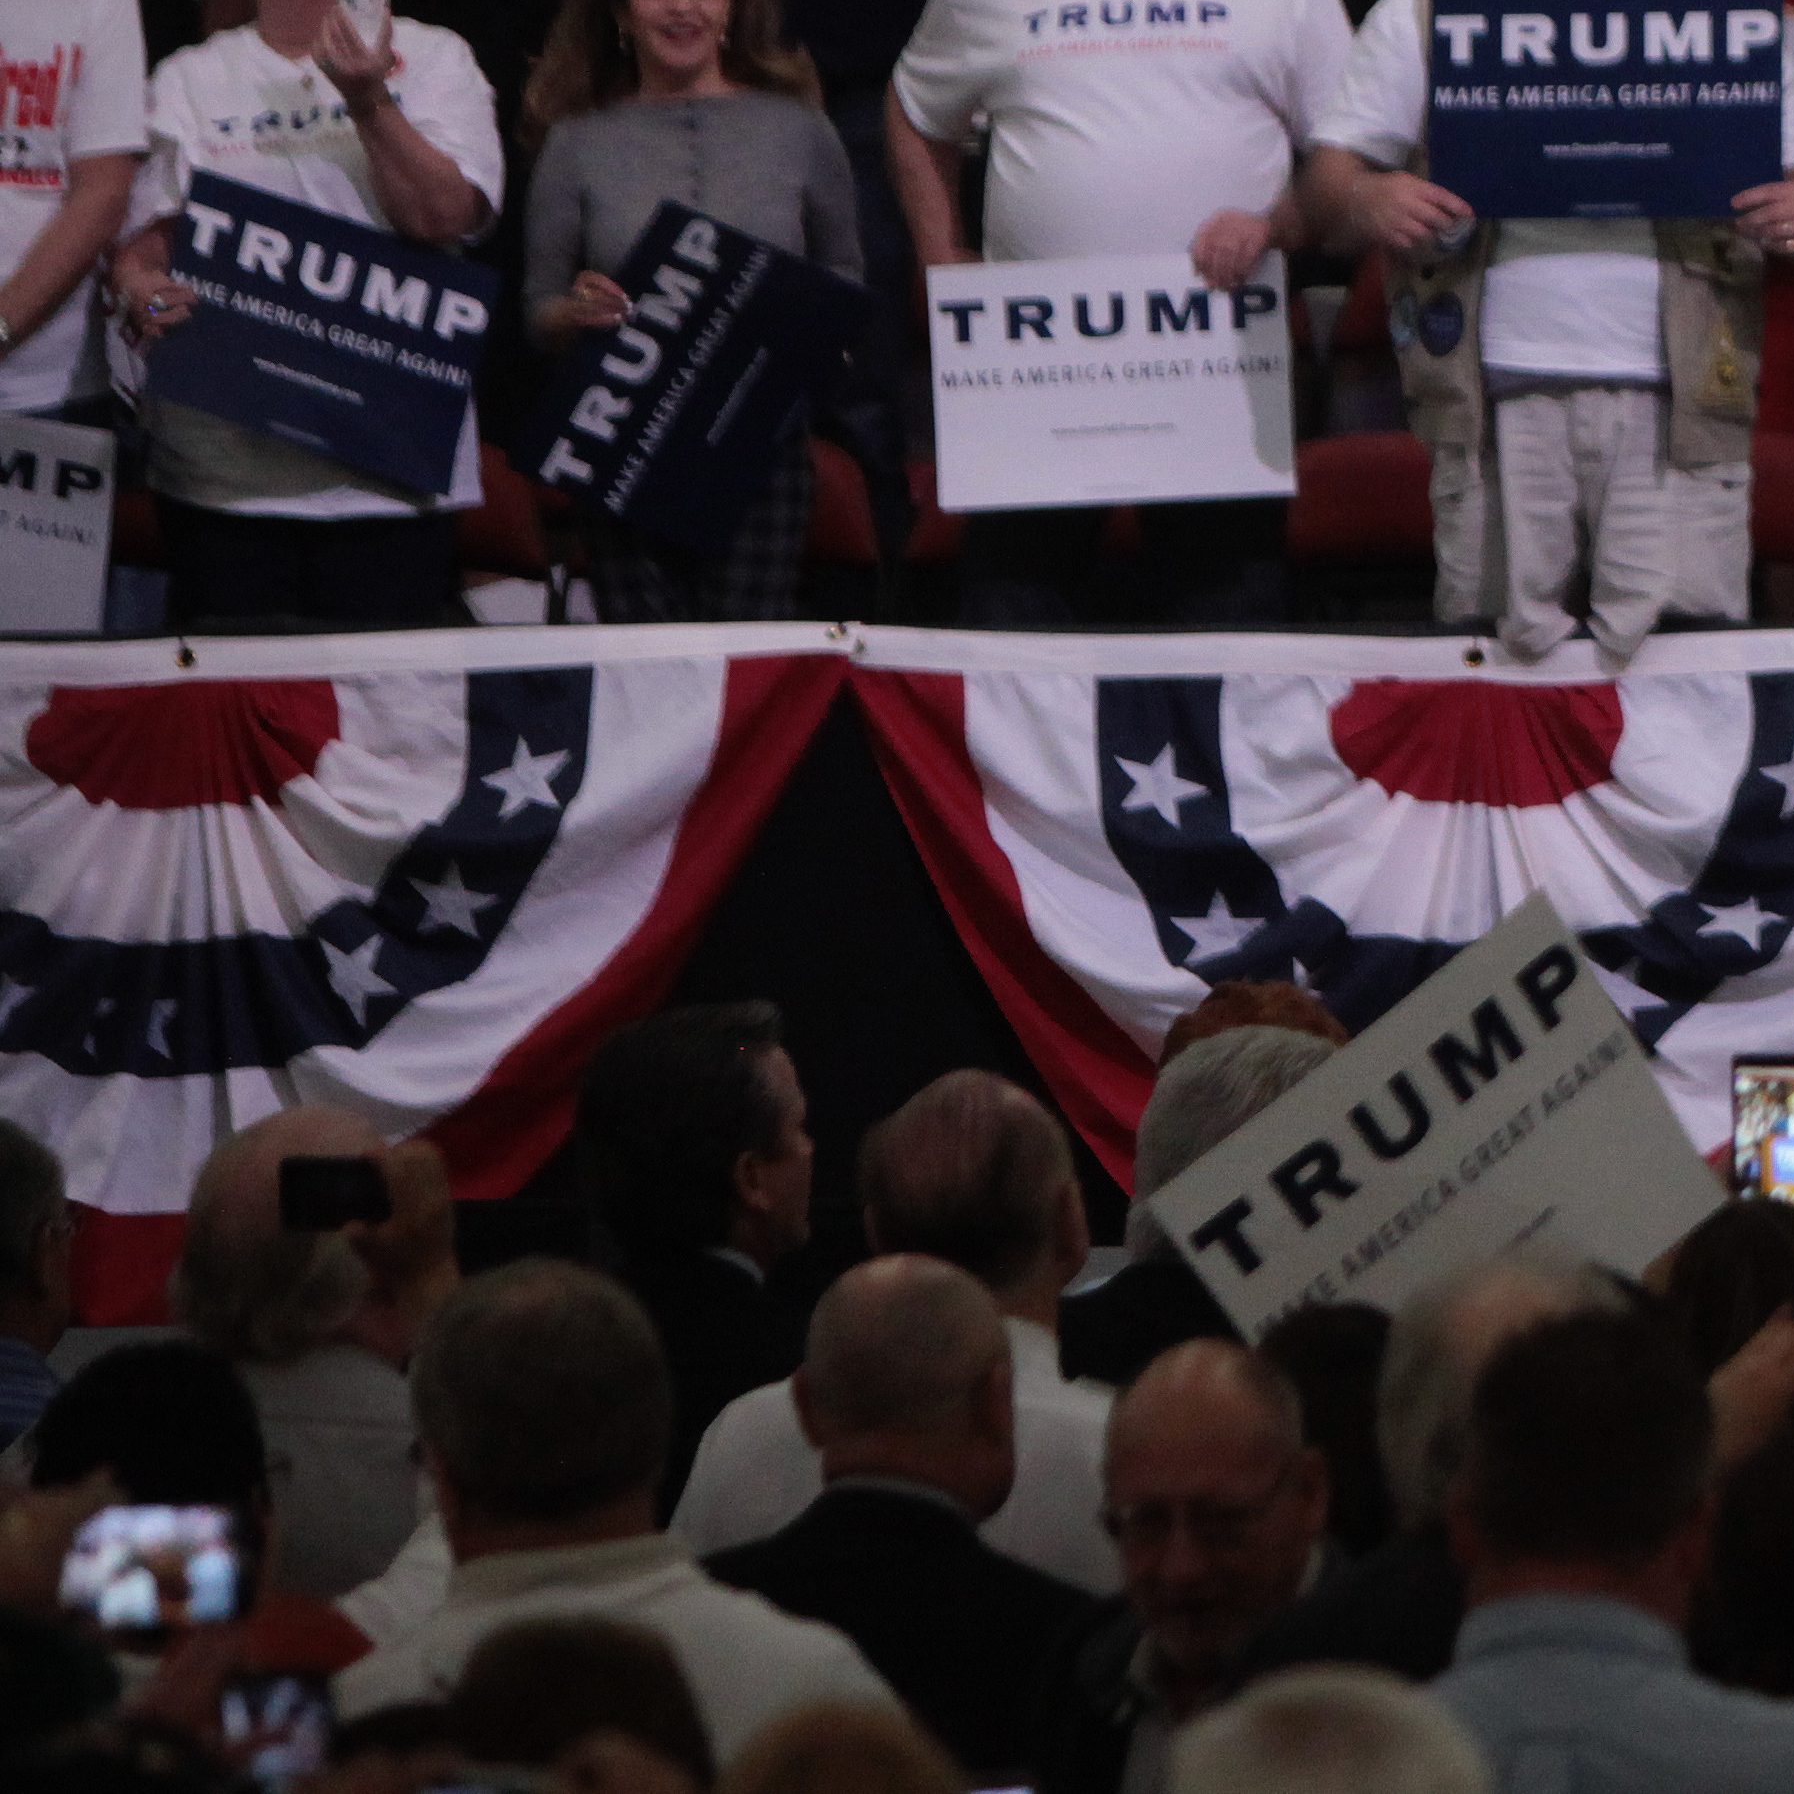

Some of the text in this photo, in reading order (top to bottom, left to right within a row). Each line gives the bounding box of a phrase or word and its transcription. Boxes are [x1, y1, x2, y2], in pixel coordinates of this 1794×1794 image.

[1025, 1, 1230, 34] TRUMP
[1434, 9, 1779, 67] TRUMP
[1434, 81, 1777, 109] MAKE AMERICA GREAT AGAIN!
[176, 203, 492, 345] TRUMP
[938, 284, 1280, 342] TRUMP
[228, 291, 327, 340] AMERICA
[325, 323, 395, 363] GREAT
[393, 347, 473, 390] AGAIN!
[539, 213, 732, 497] TRUMP
[940, 355, 1281, 388] MAKE AMERICA GREAT AGAIN!
[634, 363, 700, 456] AMERICA
[1189, 942, 1581, 1278] TRUMP
[1338, 1183, 1459, 1277] AMERICA
[1458, 1117, 1539, 1180] GREAT
